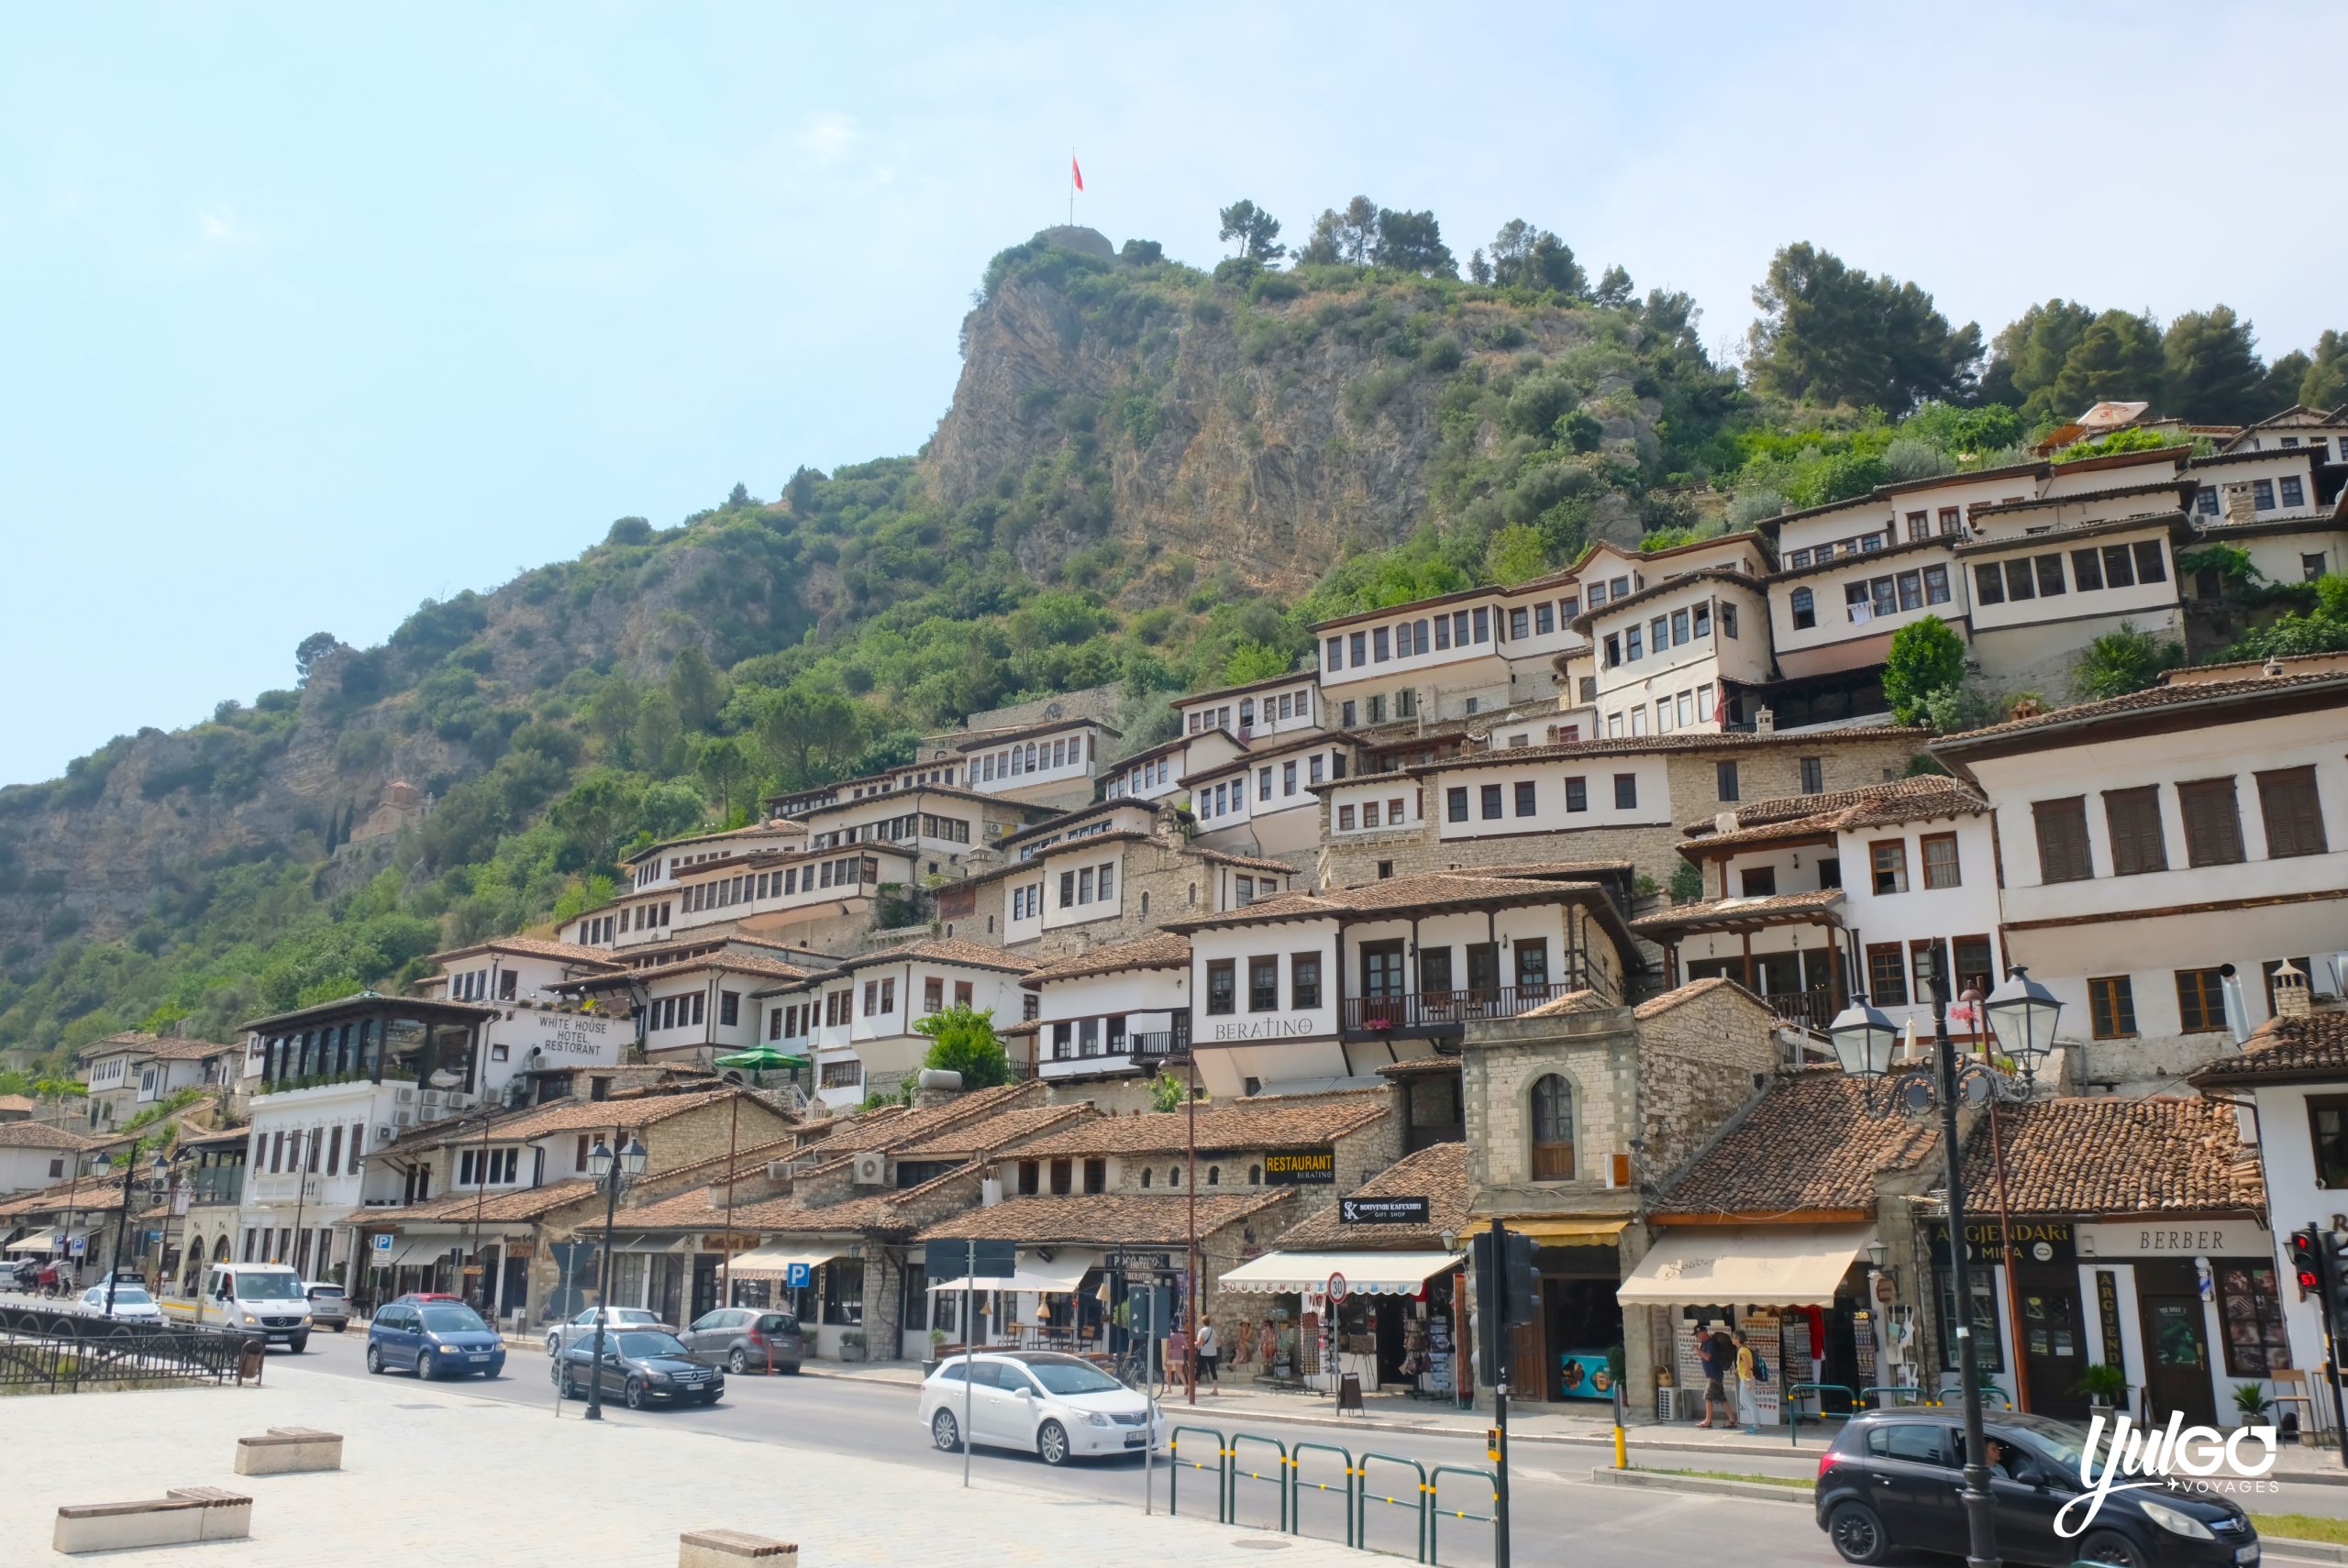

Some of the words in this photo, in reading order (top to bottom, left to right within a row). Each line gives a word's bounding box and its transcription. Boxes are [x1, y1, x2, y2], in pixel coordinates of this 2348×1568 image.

[539, 1015, 570, 1030] WHITE
[575, 1020, 607, 1034] HOUSE
[1215, 1017, 1312, 1040] BERATINO
[557, 1029, 588, 1043] HOTEL
[544, 1039, 601, 1055] RESTORANT
[1267, 1154, 1333, 1173] RESTAURANT
[1297, 1171, 1333, 1179] BERATINO
[1359, 1203, 1390, 1211] SOUVENIR
[379, 1237, 388, 1248] P
[2140, 1231, 2223, 1250] BERBER
[1130, 1261, 1150, 1270] HOTEL
[792, 1265, 805, 1284] P
[1221, 1283, 1311, 1294] SOUVENIR
[1333, 1280, 1343, 1295] 30
[1854, 1311, 1868, 1320] 250
